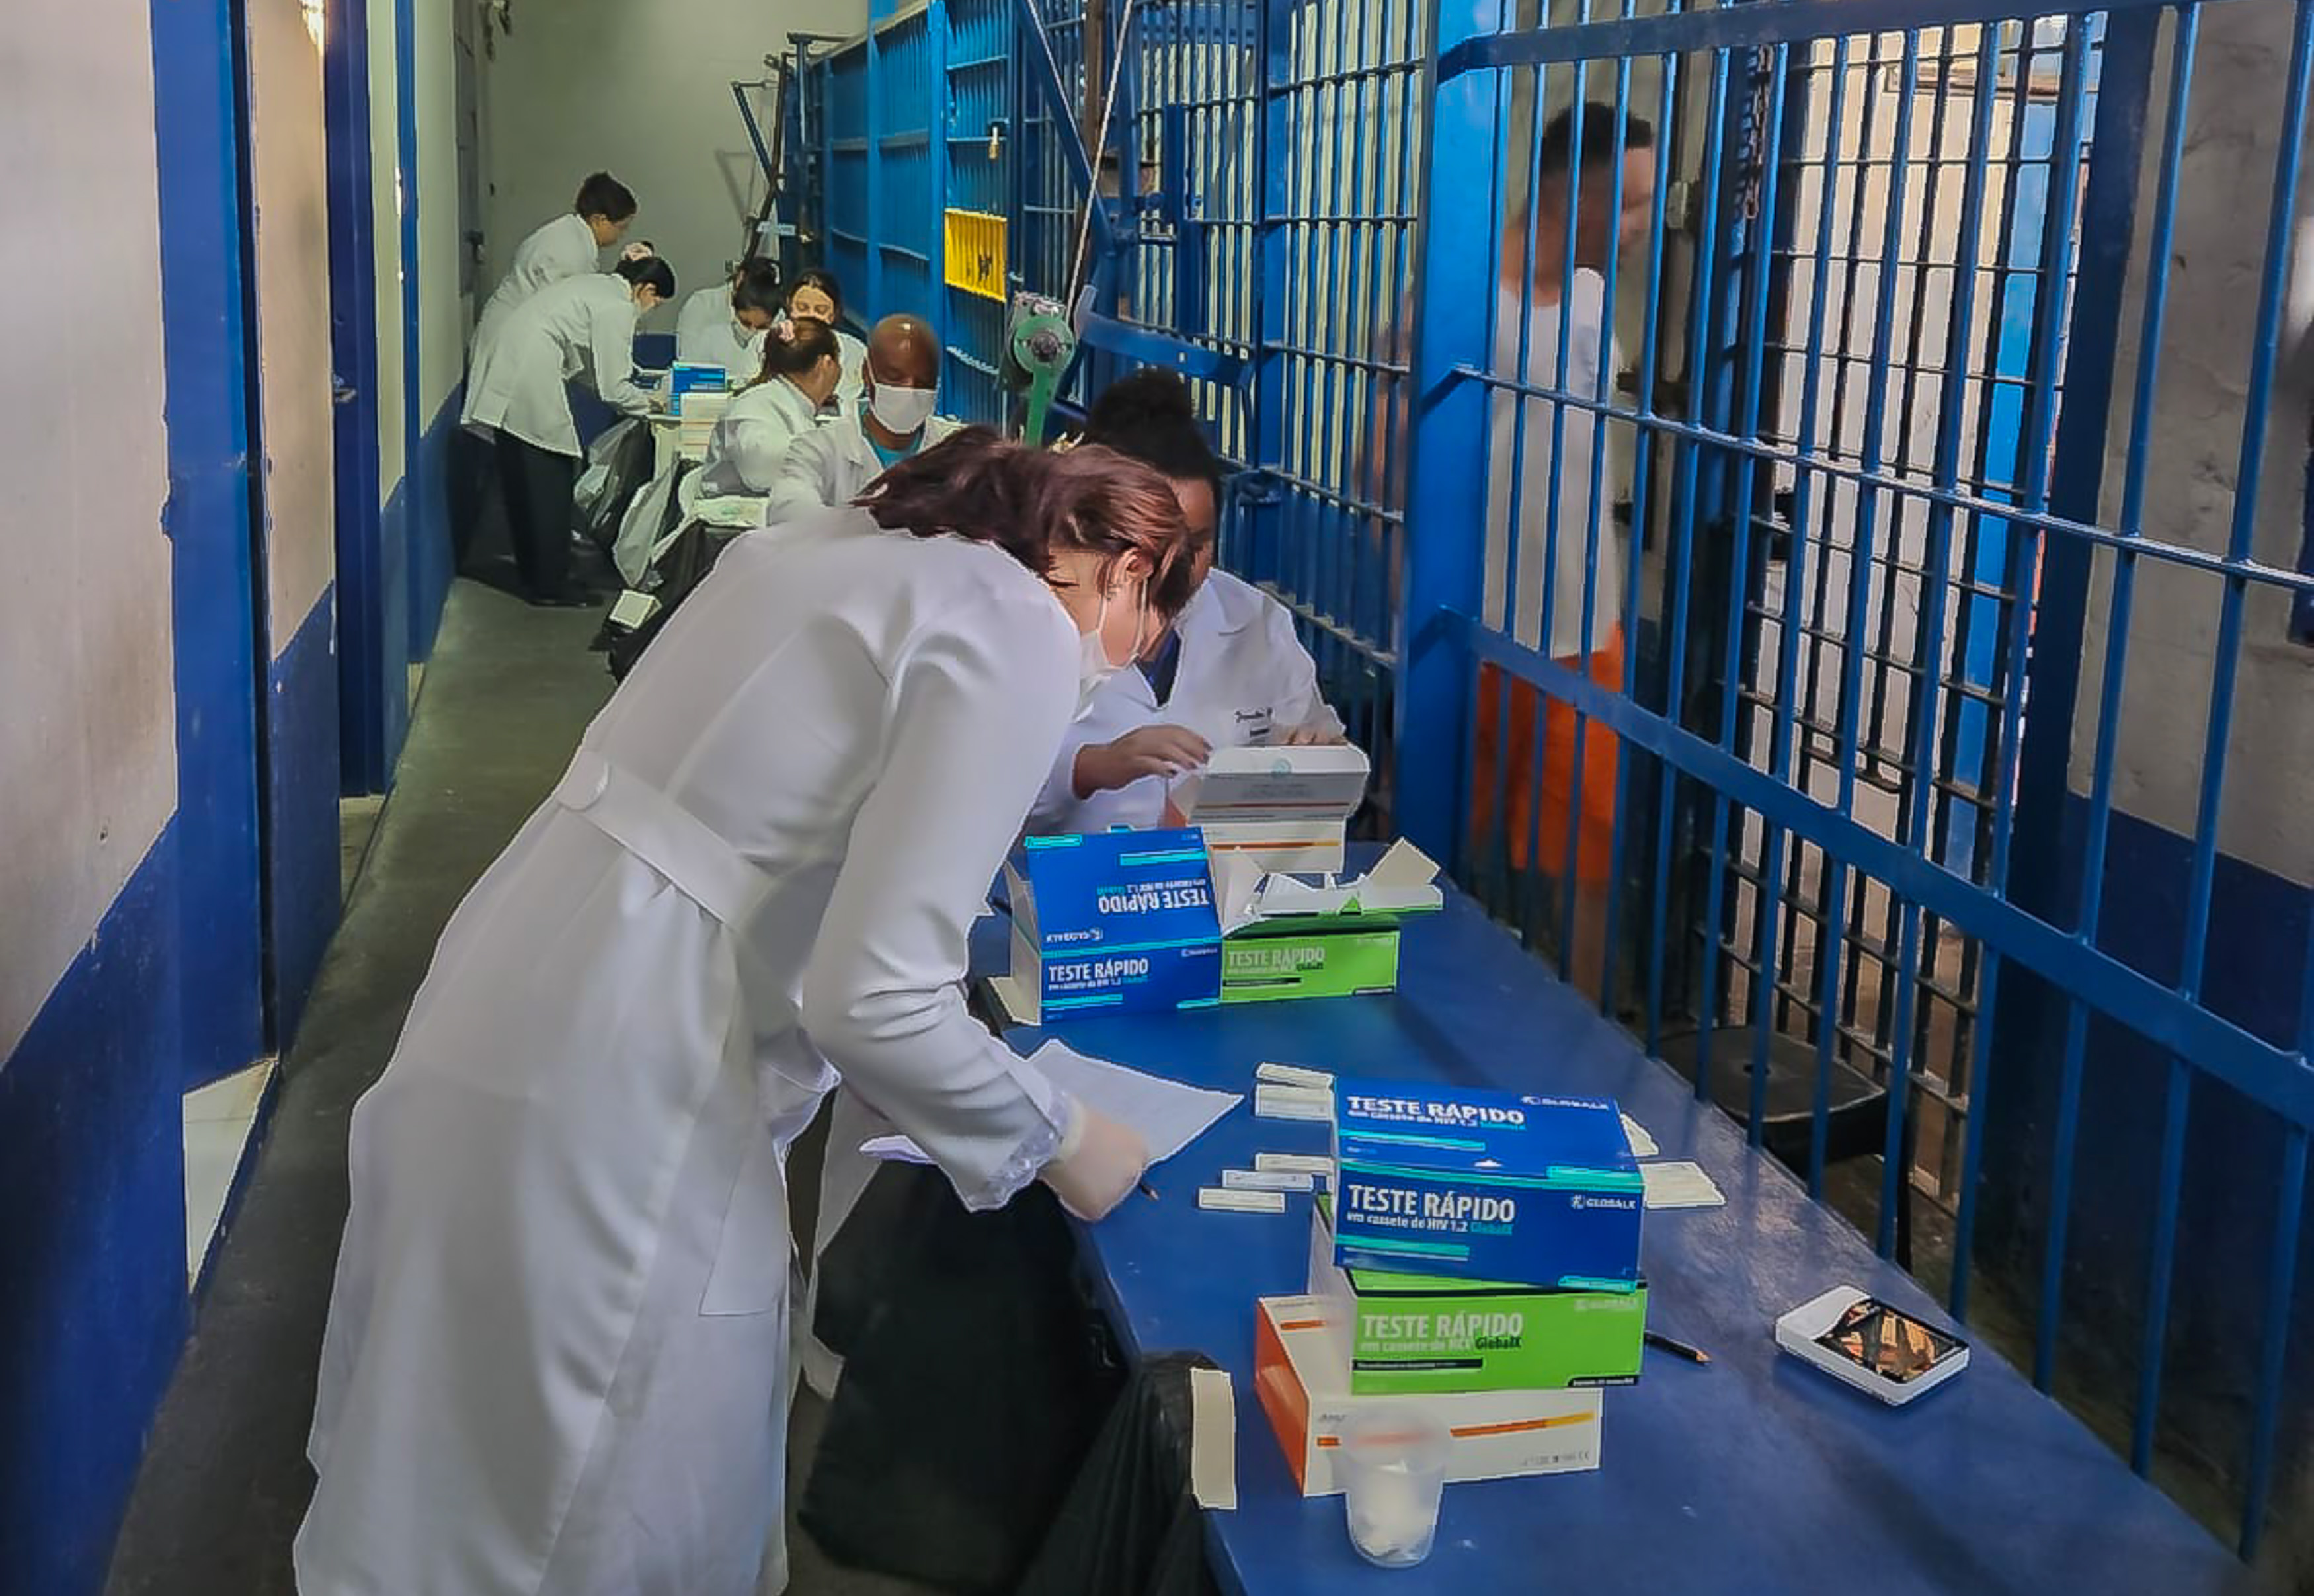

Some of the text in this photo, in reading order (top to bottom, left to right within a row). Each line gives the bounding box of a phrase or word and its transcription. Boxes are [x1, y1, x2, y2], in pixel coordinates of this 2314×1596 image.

[1097, 888, 1209, 915] TESTE RÁPIDO
[1048, 957, 1148, 982] TESTE RÁPIDO
[1229, 949, 1268, 967] TESTE
[1347, 1096, 1421, 1116] TESTE
[1347, 1184, 1515, 1222] TESTE RÁPIDO
[1361, 1310, 1523, 1339] TESTE RÁPIDO
